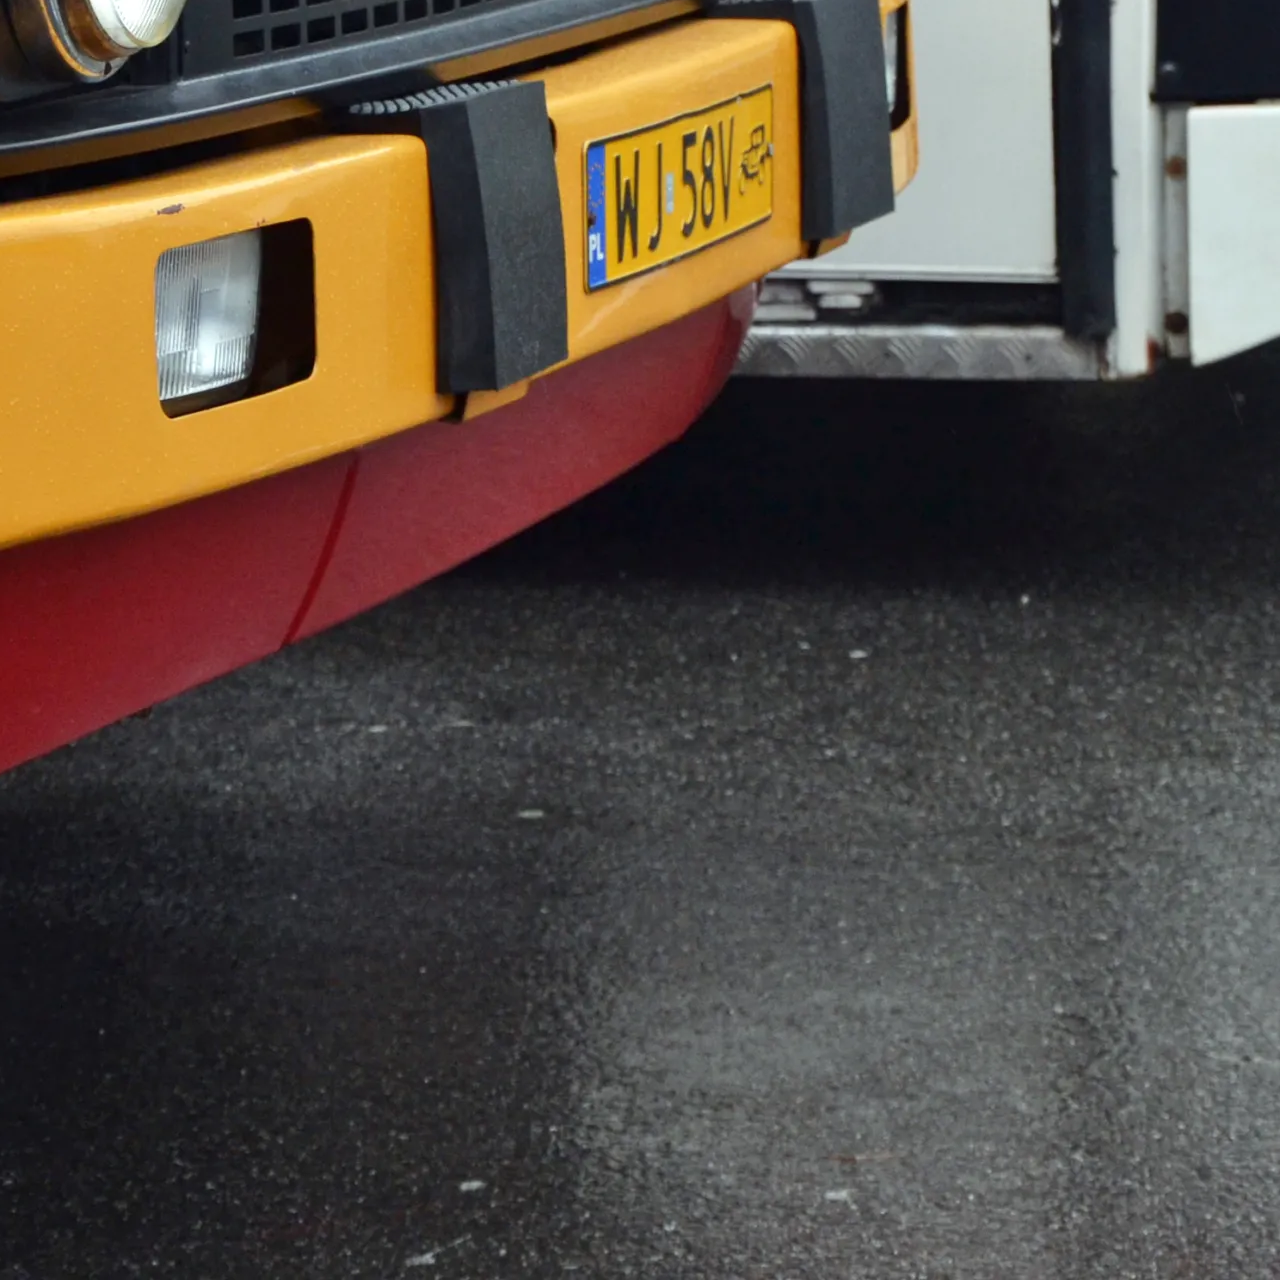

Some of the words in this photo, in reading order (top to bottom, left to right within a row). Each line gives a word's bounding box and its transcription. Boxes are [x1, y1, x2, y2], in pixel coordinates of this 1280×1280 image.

[614, 141, 663, 264] WJ
[681, 116, 734, 238] 58V
[588, 233, 605, 263] PL
